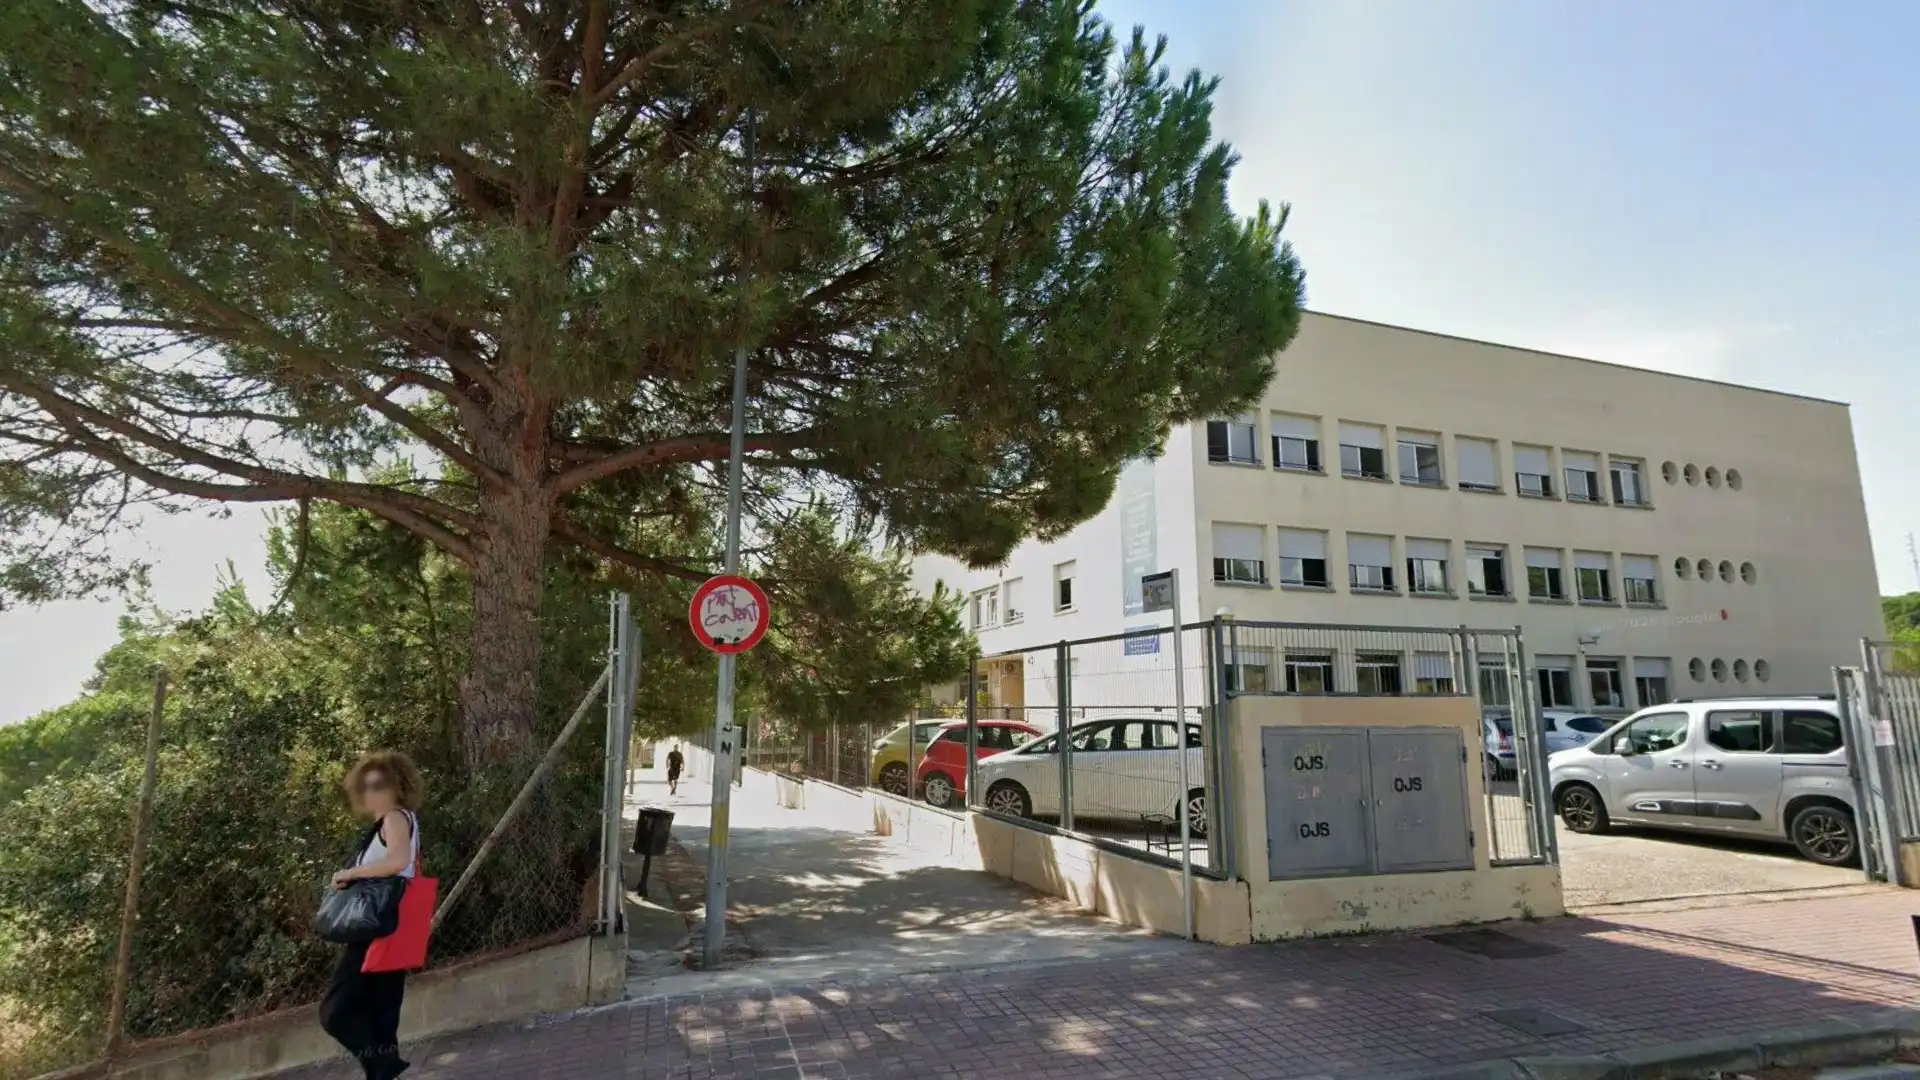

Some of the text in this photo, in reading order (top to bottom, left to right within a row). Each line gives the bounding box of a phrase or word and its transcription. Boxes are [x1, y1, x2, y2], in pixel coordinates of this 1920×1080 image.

[1294, 756, 1324, 771] OJS
[1394, 777, 1422, 793] OJS
[1300, 822, 1330, 838] OJS
